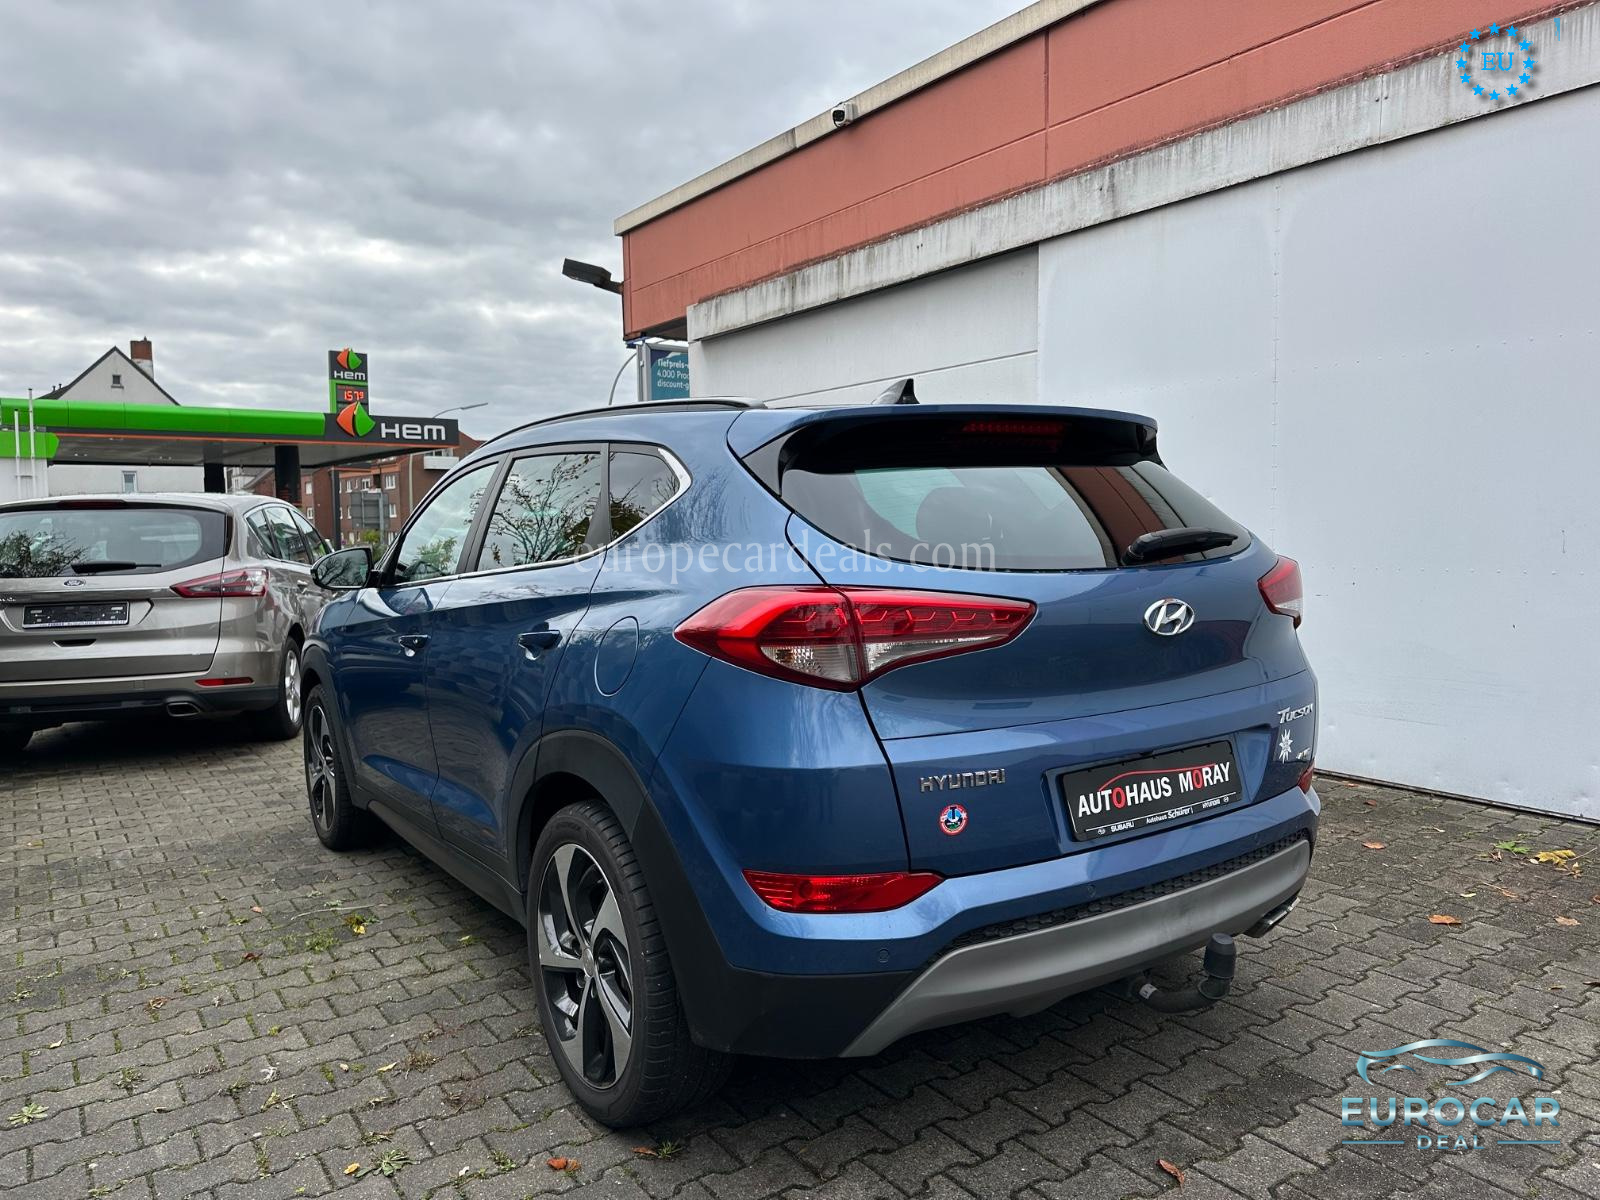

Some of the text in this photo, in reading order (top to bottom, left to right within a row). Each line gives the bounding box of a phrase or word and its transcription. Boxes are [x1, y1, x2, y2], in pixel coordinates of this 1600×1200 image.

[657, 369, 676, 379] 4.000
[920, 768, 1006, 792] HYUNDAI
[1078, 761, 1230, 818] AUTOHAUS MORAY
[1110, 820, 1135, 833] SUBARU
